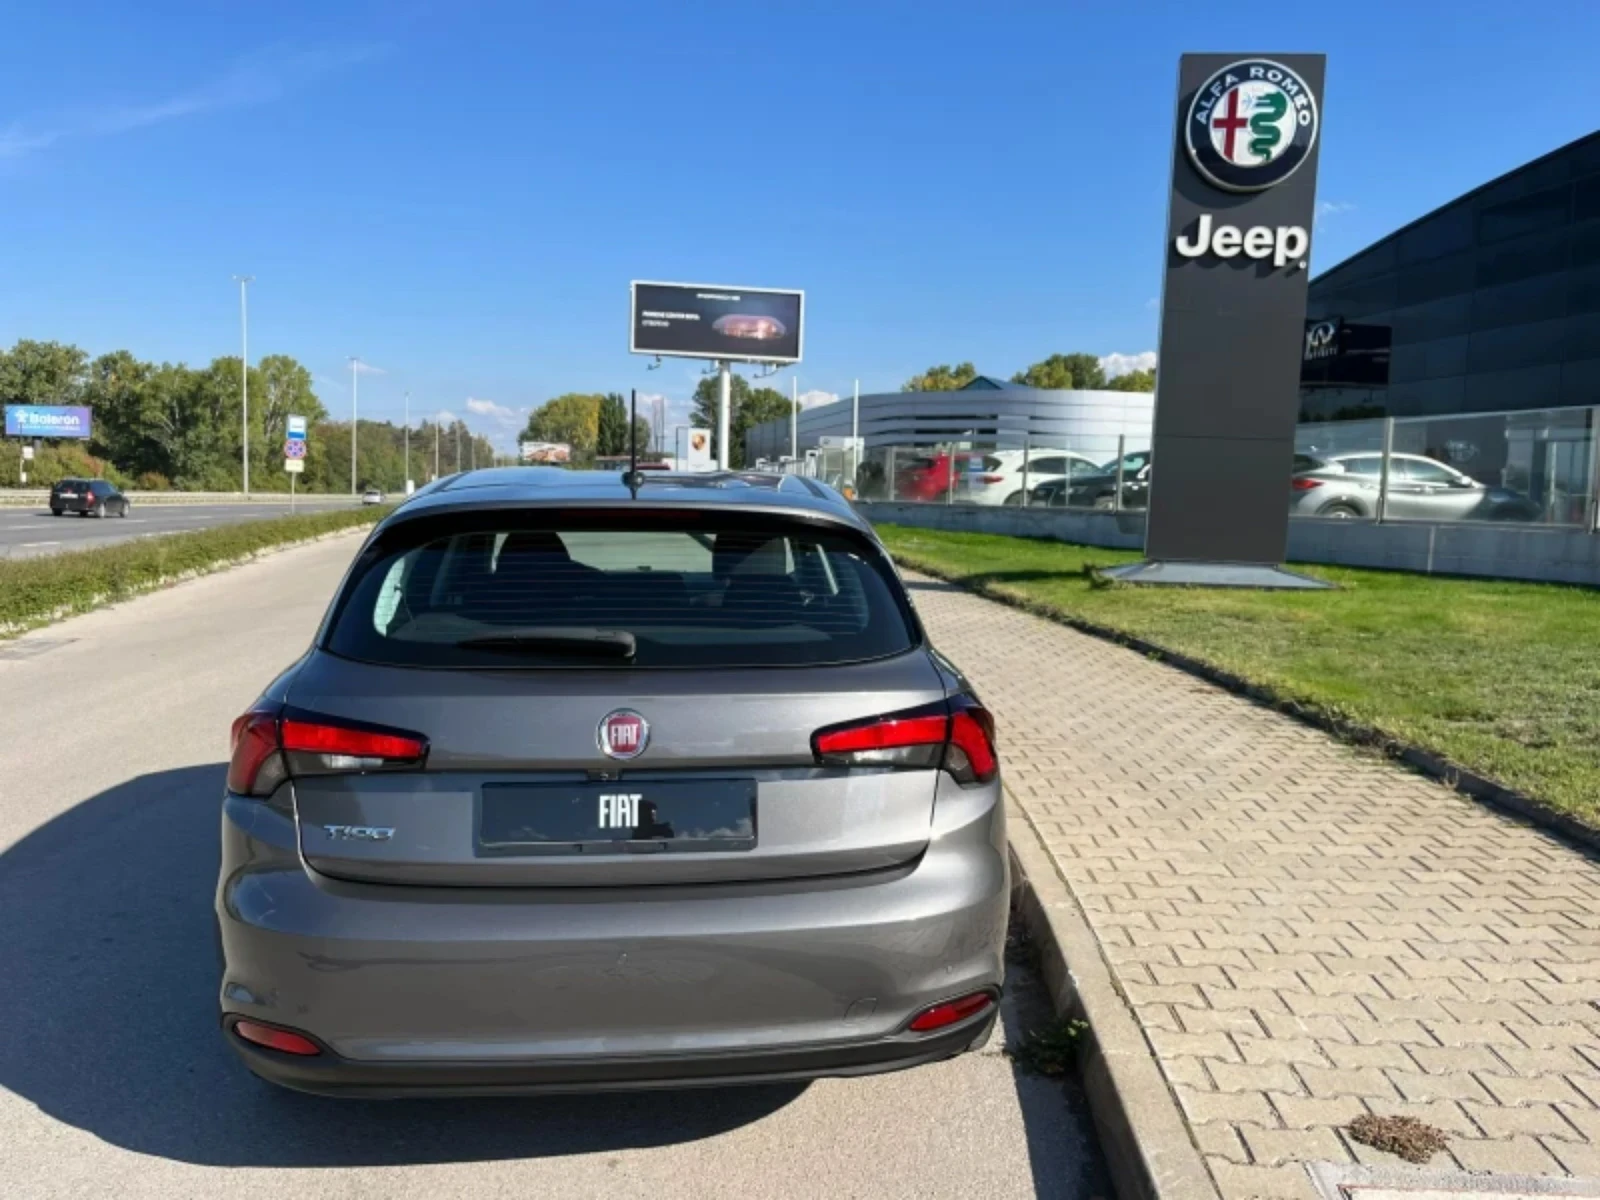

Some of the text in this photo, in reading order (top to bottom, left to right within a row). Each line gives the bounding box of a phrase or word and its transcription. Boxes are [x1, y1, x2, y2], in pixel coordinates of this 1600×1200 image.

[1196, 66, 1311, 126] ALFA ROMEO
[1176, 213, 1308, 267] Jeep
[611, 723, 639, 746] FIAT
[599, 793, 642, 828] FIAT
